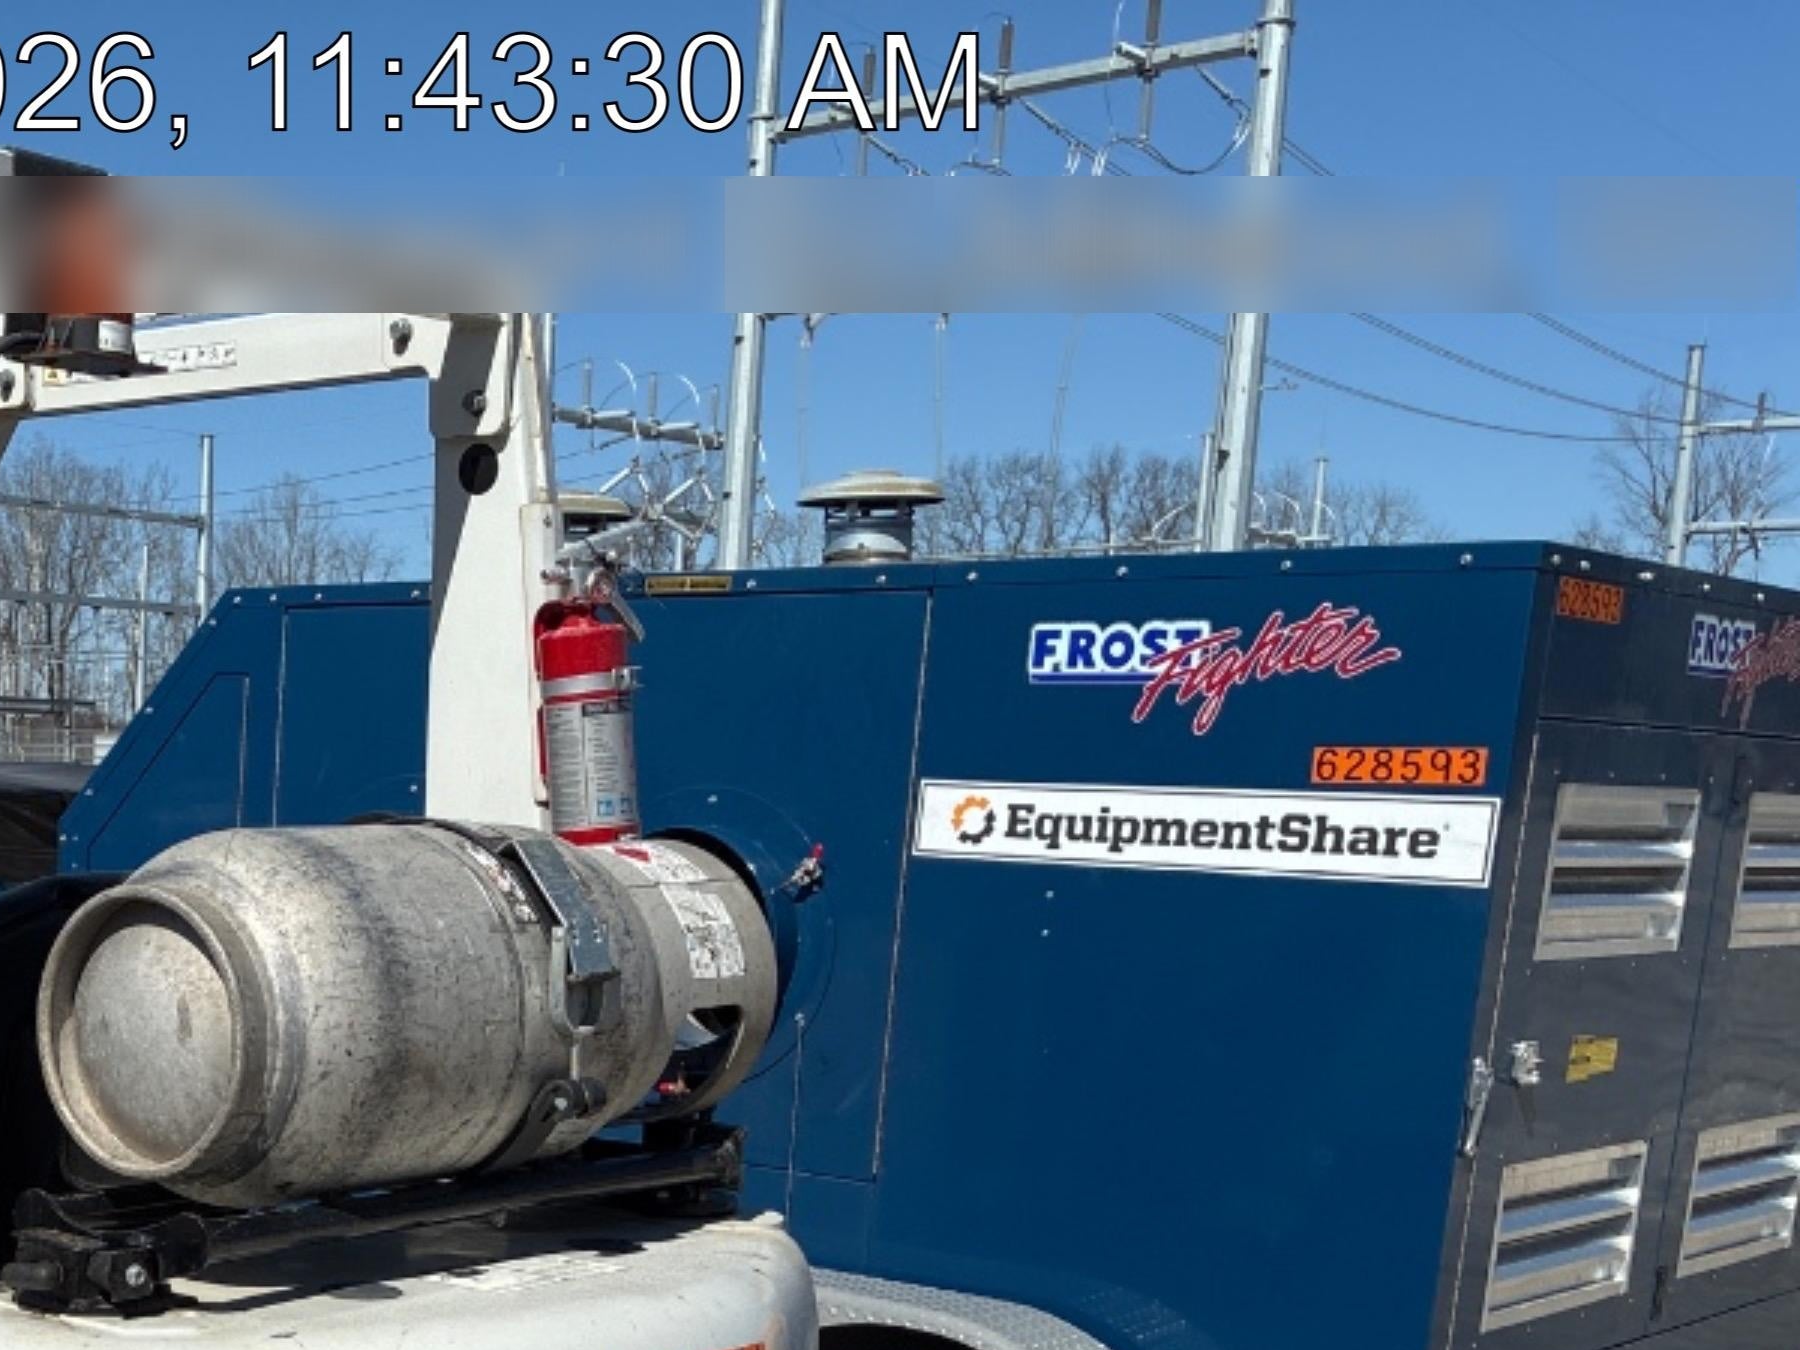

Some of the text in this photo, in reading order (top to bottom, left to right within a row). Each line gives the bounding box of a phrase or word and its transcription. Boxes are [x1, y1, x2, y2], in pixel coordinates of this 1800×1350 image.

[1030, 602, 1402, 736] FROST Fighter
[1315, 748, 1484, 785] 628593
[1003, 801, 1441, 861] EquipmentShare
